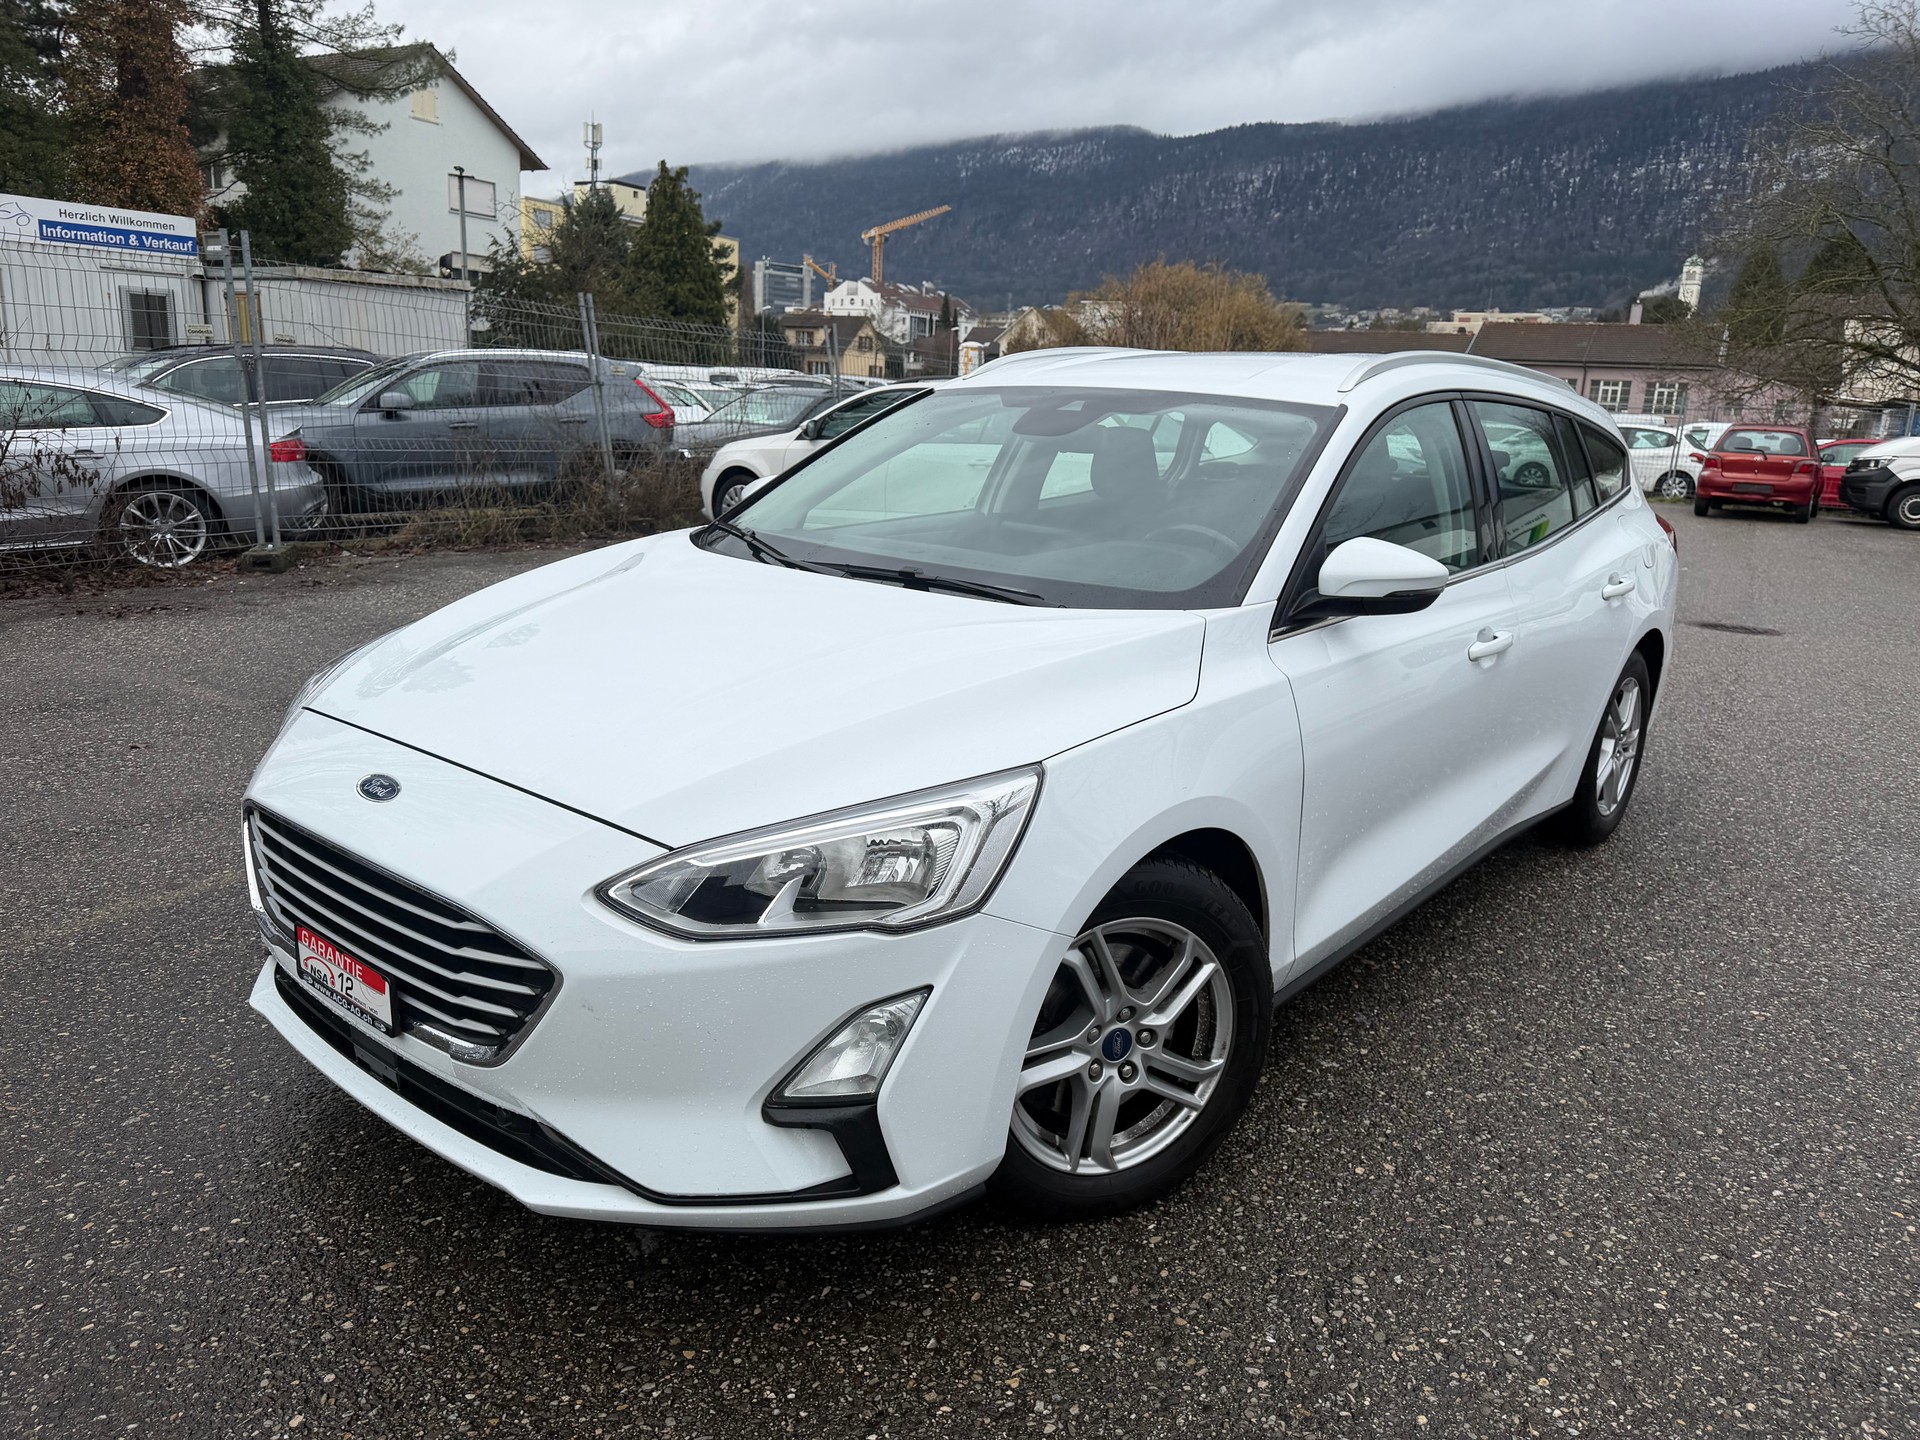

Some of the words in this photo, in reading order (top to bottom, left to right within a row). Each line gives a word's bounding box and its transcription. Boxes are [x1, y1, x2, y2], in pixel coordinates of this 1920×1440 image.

[58, 208, 106, 223] Herzlich
[108, 214, 176, 231] Willkommen
[42, 224, 125, 245] Information
[128, 234, 140, 246] &
[142, 235, 193, 252] Verkauf
[363, 778, 392, 797] Ford
[301, 930, 363, 981] GARANTIE
[310, 964, 329, 985] NSA
[338, 972, 354, 999] 12
